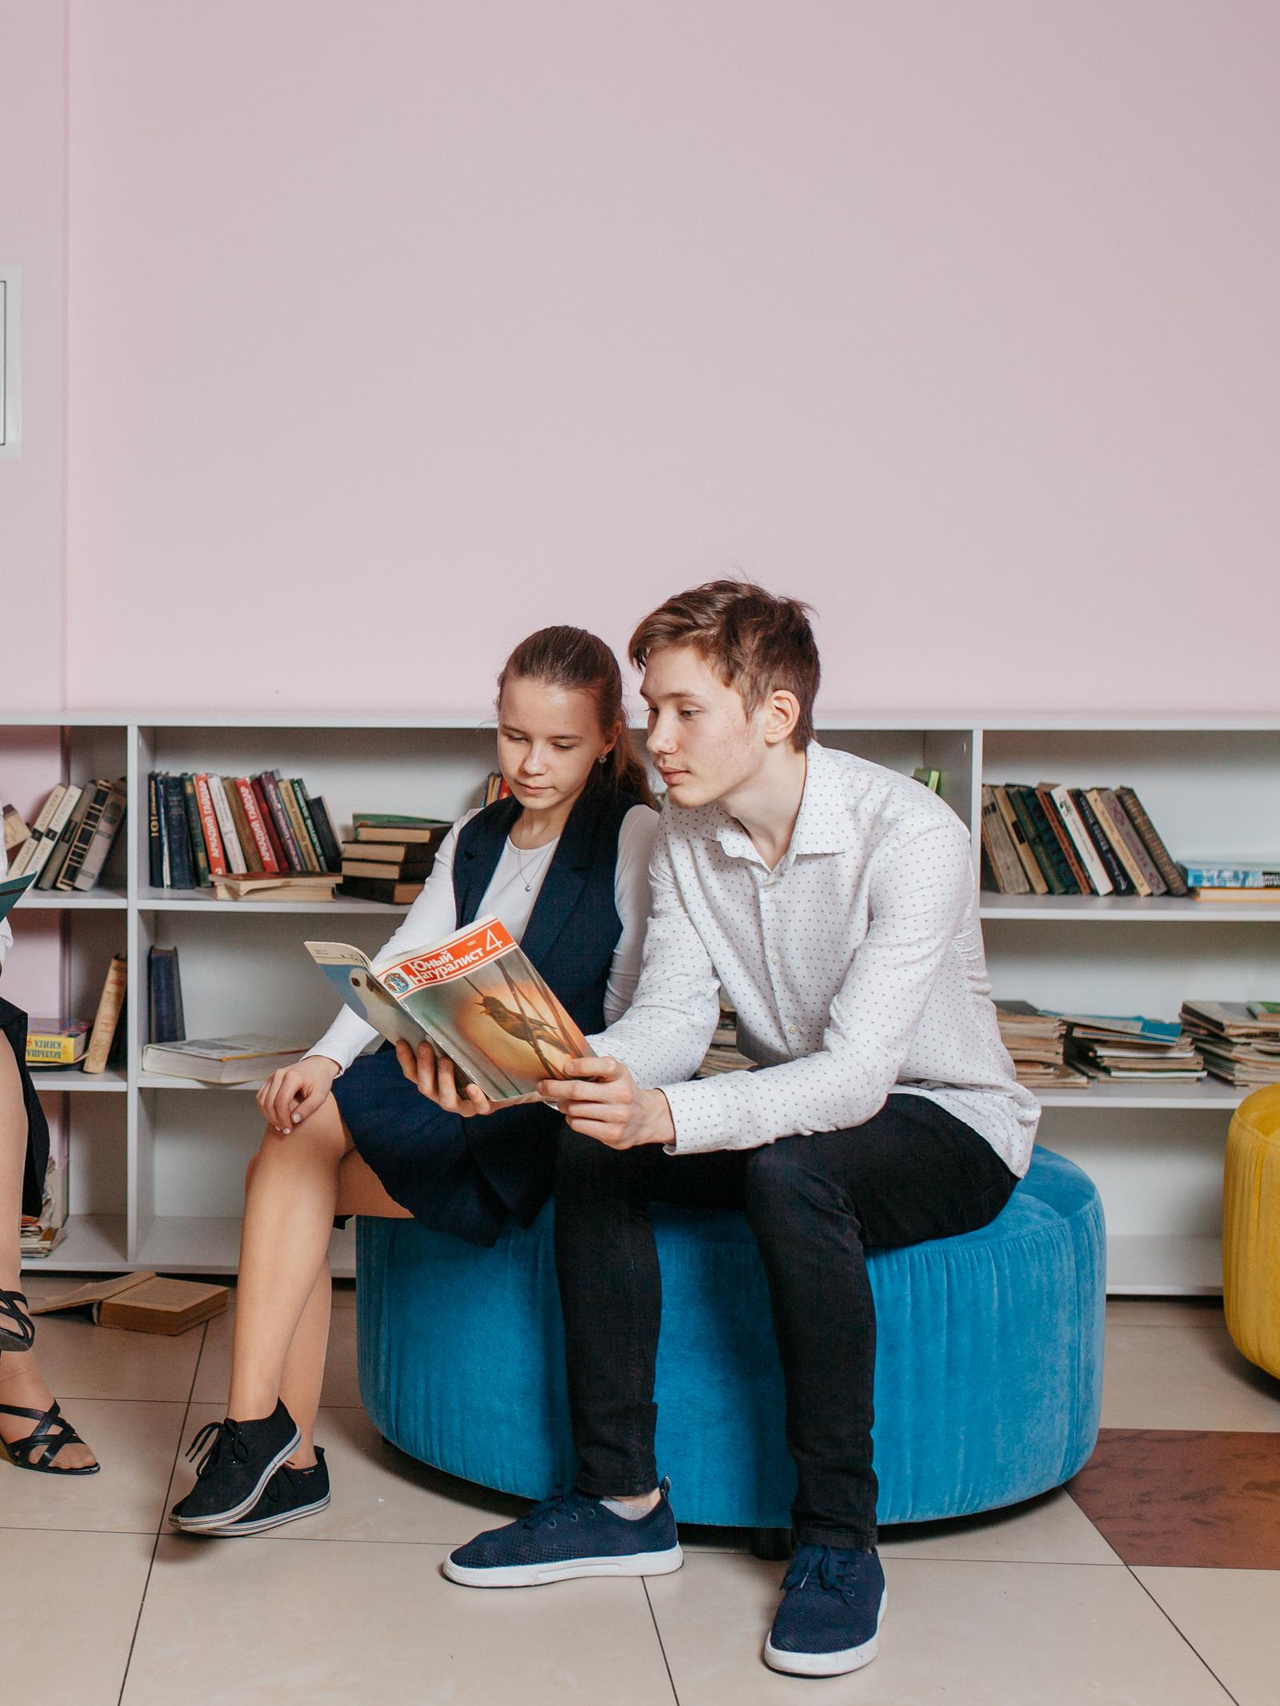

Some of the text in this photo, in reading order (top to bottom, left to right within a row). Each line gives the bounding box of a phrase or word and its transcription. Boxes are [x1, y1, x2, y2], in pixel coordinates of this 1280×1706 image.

[198, 780, 213, 814] ГАЙДАР
[204, 815, 221, 858] АРКАДИЙ
[240, 786, 271, 862] АРКАДИЙ ГАЙДАР
[485, 928, 503, 952] 4
[408, 949, 455, 973] Юный
[409, 947, 484, 986] Натуралист
[26, 1049, 62, 1059] БОЛЬША
[34, 1040, 62, 1050] КНИГА
